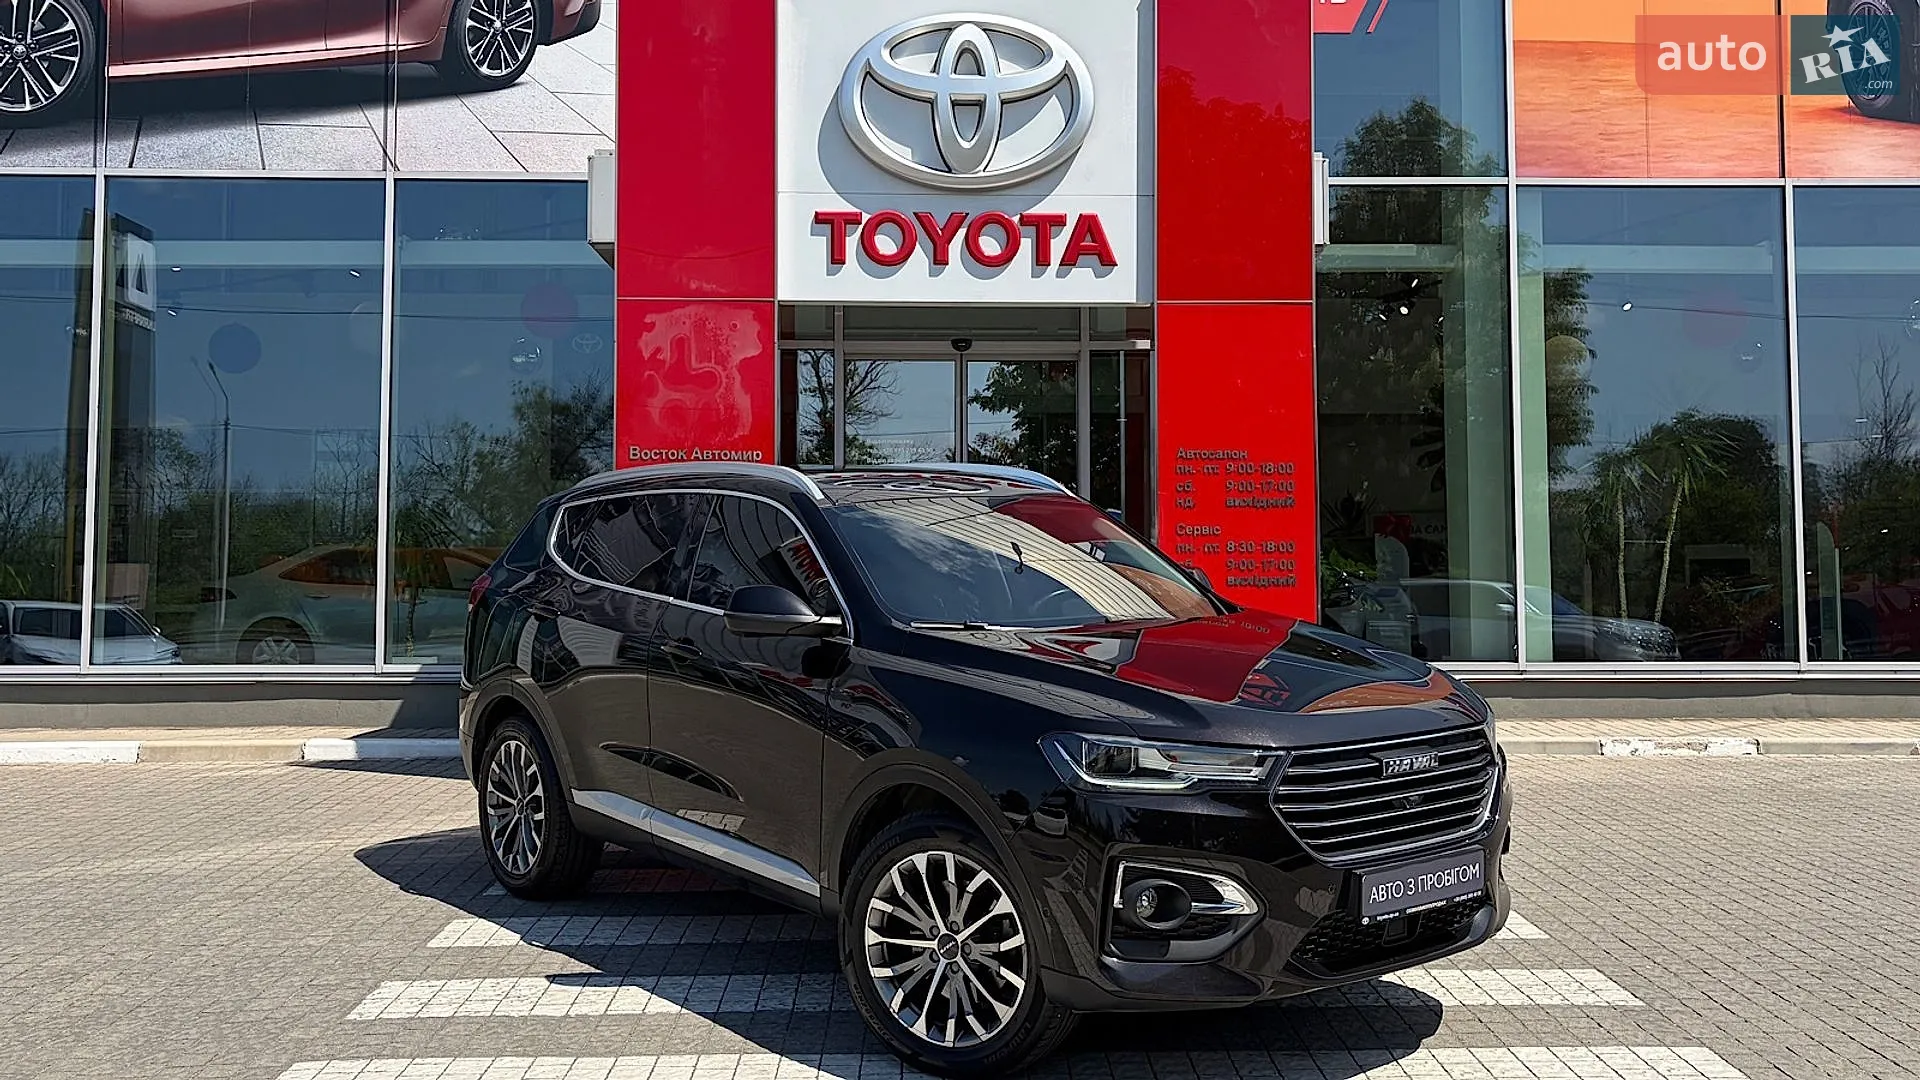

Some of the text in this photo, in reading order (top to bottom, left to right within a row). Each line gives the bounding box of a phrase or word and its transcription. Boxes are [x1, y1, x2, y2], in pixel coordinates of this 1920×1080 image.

[814, 210, 1119, 268] TOYOTA
[629, 446, 763, 462] Восток Автомир
[1177, 448, 1248, 459] Автосалон
[1177, 523, 1221, 536] Сервіс
[1386, 754, 1439, 774] HAVAL
[1369, 880, 1404, 904] АВТО
[1418, 862, 1480, 893] ПРОБІГОМ
